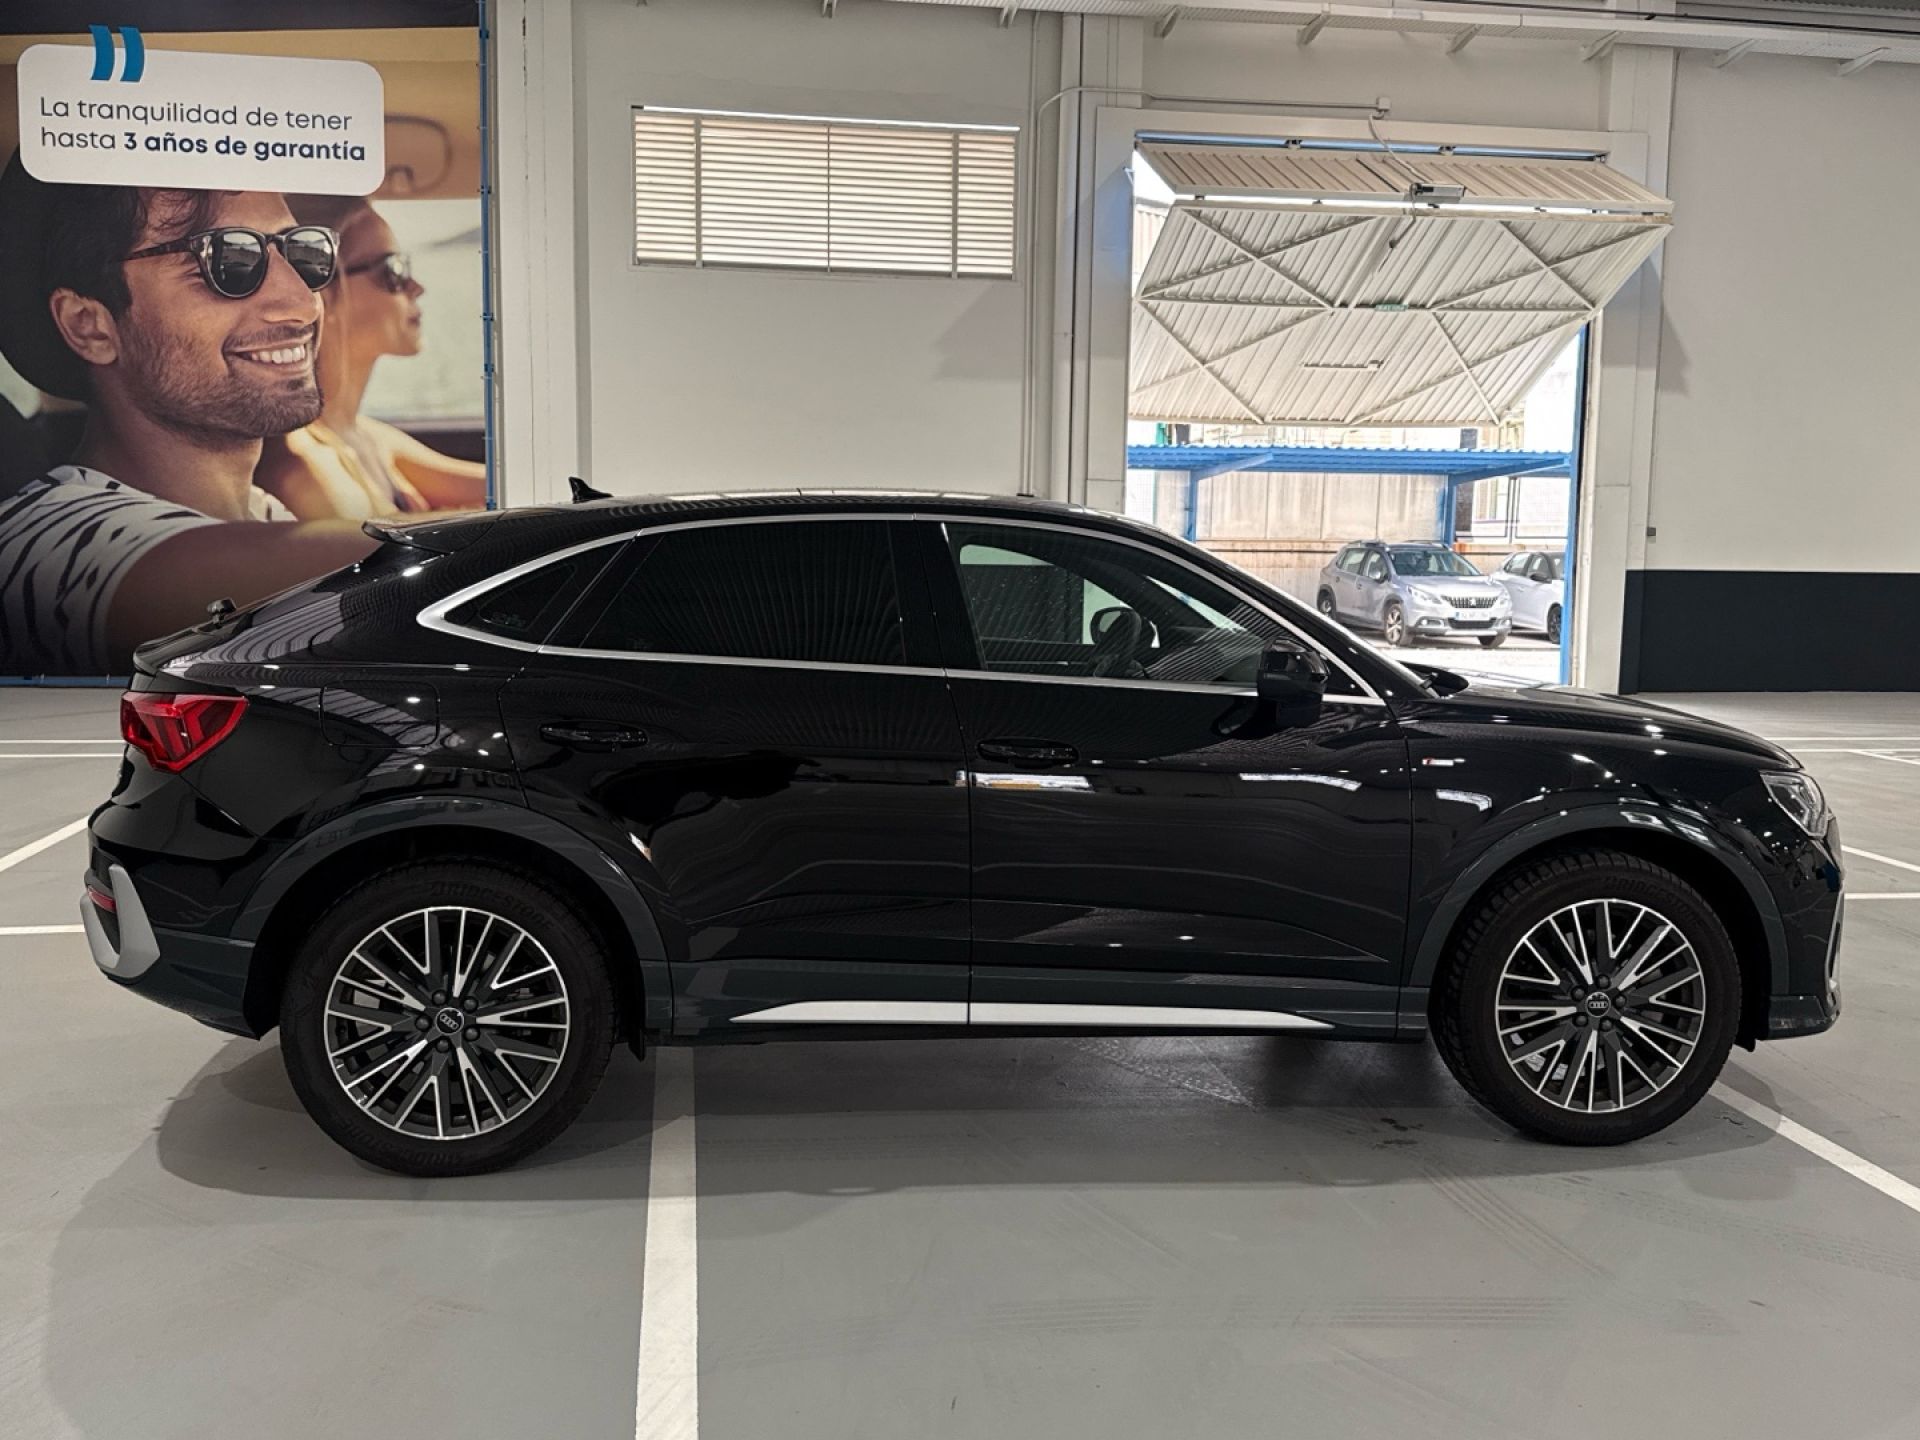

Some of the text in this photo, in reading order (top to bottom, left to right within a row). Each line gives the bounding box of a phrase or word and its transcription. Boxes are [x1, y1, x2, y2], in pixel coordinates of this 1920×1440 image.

[40, 96, 353, 131] La tranquilidad de tener
[41, 126, 366, 162] hasta 3 años de garantía
